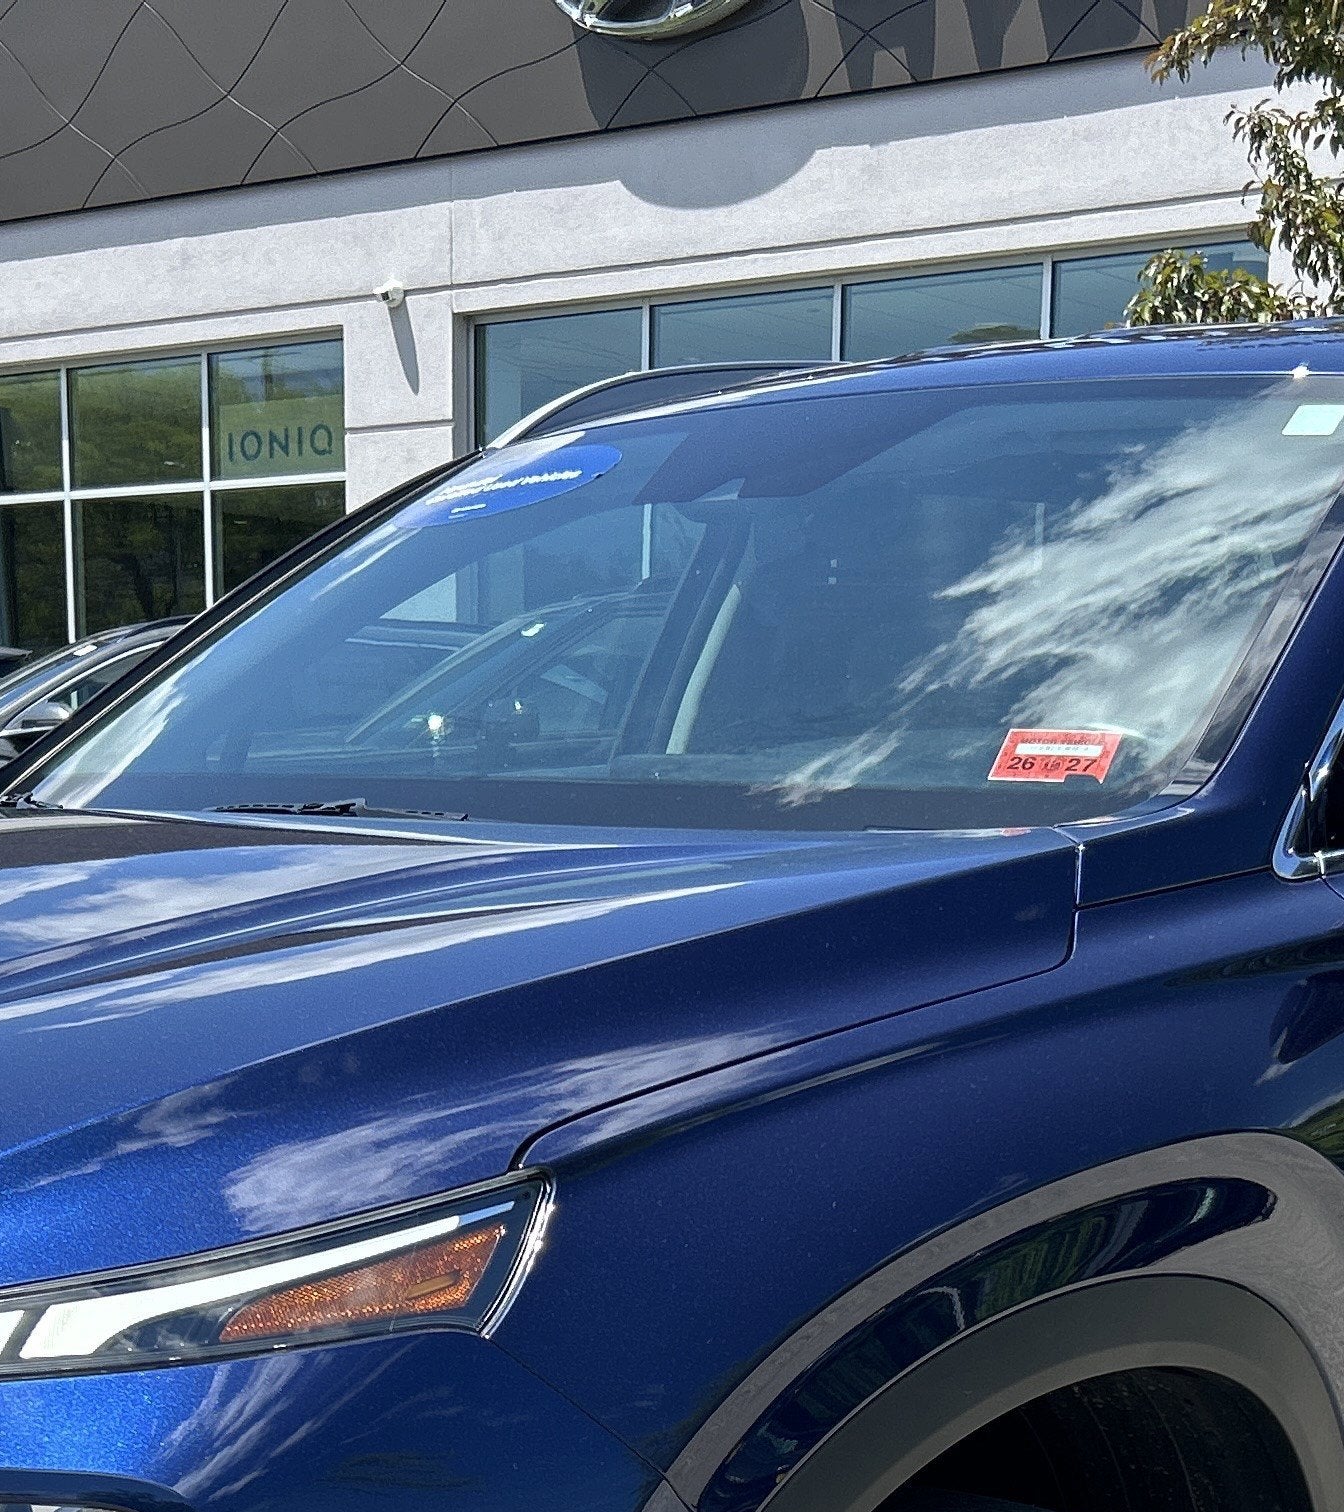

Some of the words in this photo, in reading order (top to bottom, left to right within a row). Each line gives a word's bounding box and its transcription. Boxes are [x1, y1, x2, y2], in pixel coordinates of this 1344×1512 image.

[227, 423, 333, 462] IONIQ
[1006, 756, 1037, 771] 26
[1064, 757, 1098, 773] 27
